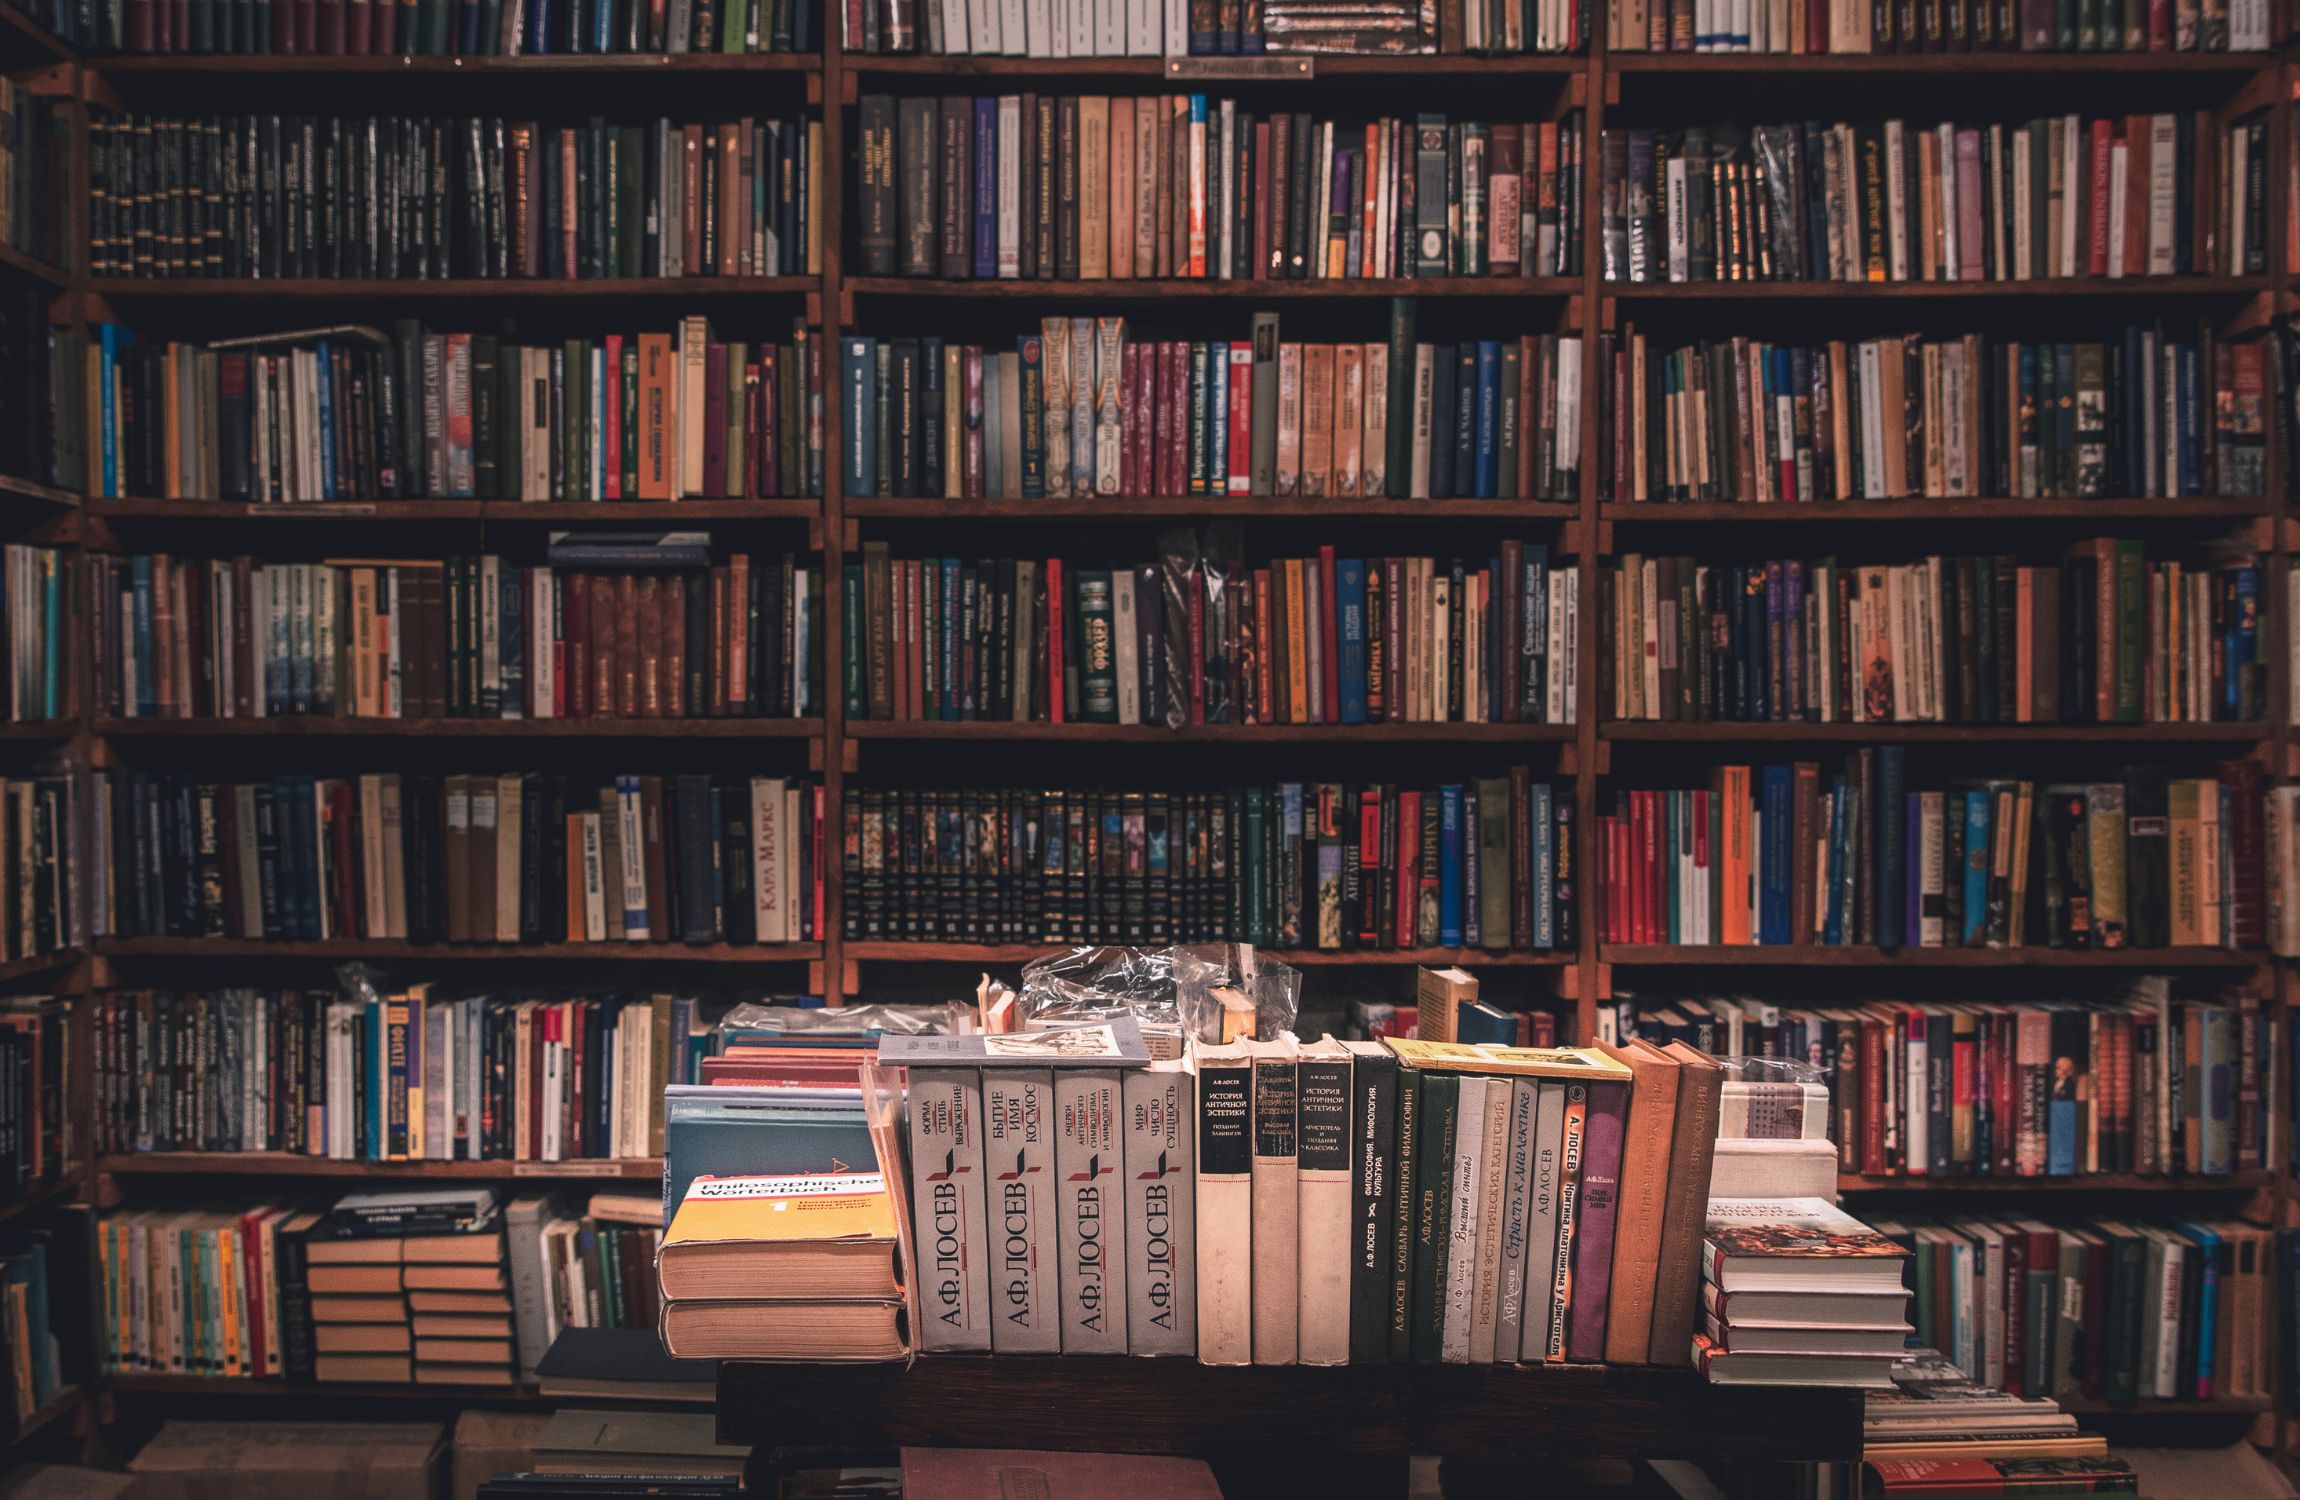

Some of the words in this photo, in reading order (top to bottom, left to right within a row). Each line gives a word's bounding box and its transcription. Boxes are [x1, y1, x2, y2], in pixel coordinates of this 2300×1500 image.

[1371, 640, 1382, 693] АМЕРИКА
[759, 801, 775, 862] МАРКС
[1422, 818, 1439, 878] ГЕНРИХ
[761, 867, 776, 911] КАРЛ
[1346, 844, 1360, 901] АНГЛИИ
[953, 1085, 964, 1145] ВЫРАЖЕНИЕ
[991, 1090, 1004, 1139] БЫТИЕ
[1009, 1098, 1020, 1131] ИМЯ
[1024, 1083, 1037, 1143] КОСМОС
[1101, 1088, 1109, 1142] МИФОЛОГИИ
[1205, 1100, 1247, 1108] АНТИЧНОЙ
[1207, 1109, 1245, 1117] ЭСТЕТИКИ
[1209, 1092, 1243, 1100] ИСТОРИЯ
[1301, 1096, 1345, 1104] АНТИЧНОЙ
[1303, 1104, 1343, 1112] ЭСТЕТИКИ
[1305, 1088, 1340, 1096] ИСТОРИЯ
[1366, 1084, 1377, 1139] МИФОЛОГИЯ.
[922, 1100, 931, 1135] ФОРМА
[938, 1100, 947, 1133] СТИЛЬ
[1065, 1104, 1073, 1137] ОЧЕРКИ
[1077, 1095, 1085, 1146] АНТИЧНОГО
[1090, 1091, 1098, 1149] СИМВОЛИЗМА
[1135, 1104, 1144, 1131] МИФ
[1150, 1098, 1160, 1137] ЧИСЛО
[1166, 1085, 1176, 1149] СУЩНОСТЬ
[1402, 1088, 1413, 1157] ФИЛОСОФИИ
[1492, 1101, 1506, 1173] КАТЕГОРИЙ
[1515, 1091, 1530, 1182] диалектике
[1569, 1115, 1580, 1128] А.
[1364, 1141, 1375, 1196] ФИЛОСОФИЯ.
[1460, 1154, 1473, 1193] синтез
[1566, 1131, 1579, 1170] ЛОСЕВ
[1374, 1156, 1383, 1197] КУЛЬТУРА
[1399, 1160, 1410, 1221] АНТИЧНОЙ
[1515, 1184, 1524, 1194] к
[769, 1201, 788, 1212] 1
[1454, 1193, 1473, 1244] Высший
[1483, 1174, 1500, 1266] ЭСТЕТИЧЕСКИХ
[1505, 1197, 1522, 1260] Страсть
[1563, 1183, 1575, 1226] Критика
[1396, 1225, 1408, 1273] СЛОВАРЬ
[1456, 1258, 1466, 1285] Лосев
[1555, 1225, 1570, 1289] платонизма
[1479, 1269, 1493, 1326] ИСТОРИЯ
[1559, 1288, 1566, 1297] у
[1550, 1297, 1566, 1357] Аристотеля
